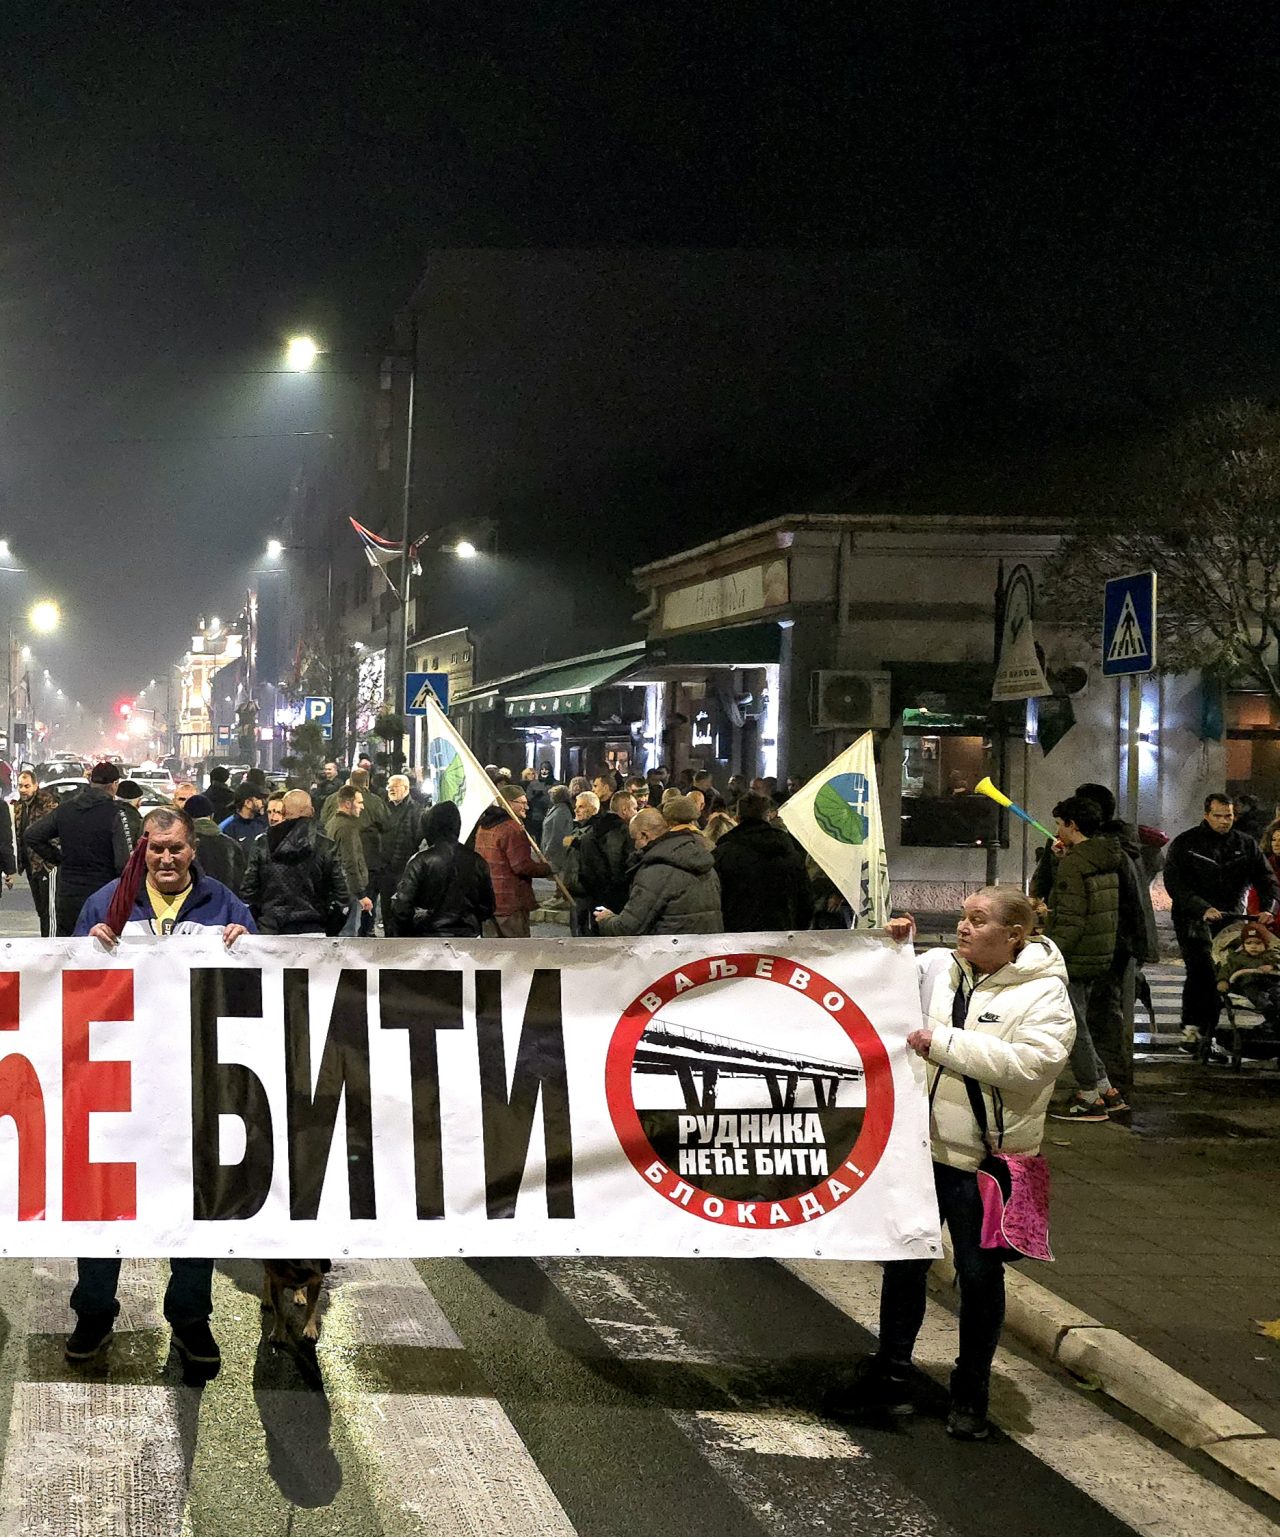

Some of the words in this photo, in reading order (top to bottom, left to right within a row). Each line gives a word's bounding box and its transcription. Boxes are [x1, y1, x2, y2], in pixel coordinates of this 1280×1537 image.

[311, 701, 326, 720] P
[639, 957, 845, 1013] ВАЉЕВО
[190, 967, 576, 1221] БИТИ
[678, 1113, 826, 1148] РУДНИКА
[679, 1149, 749, 1176] НЕЋЕ
[755, 1148, 829, 1176] БИТИ
[644, 1160, 865, 1225] БЛОКАДА!
